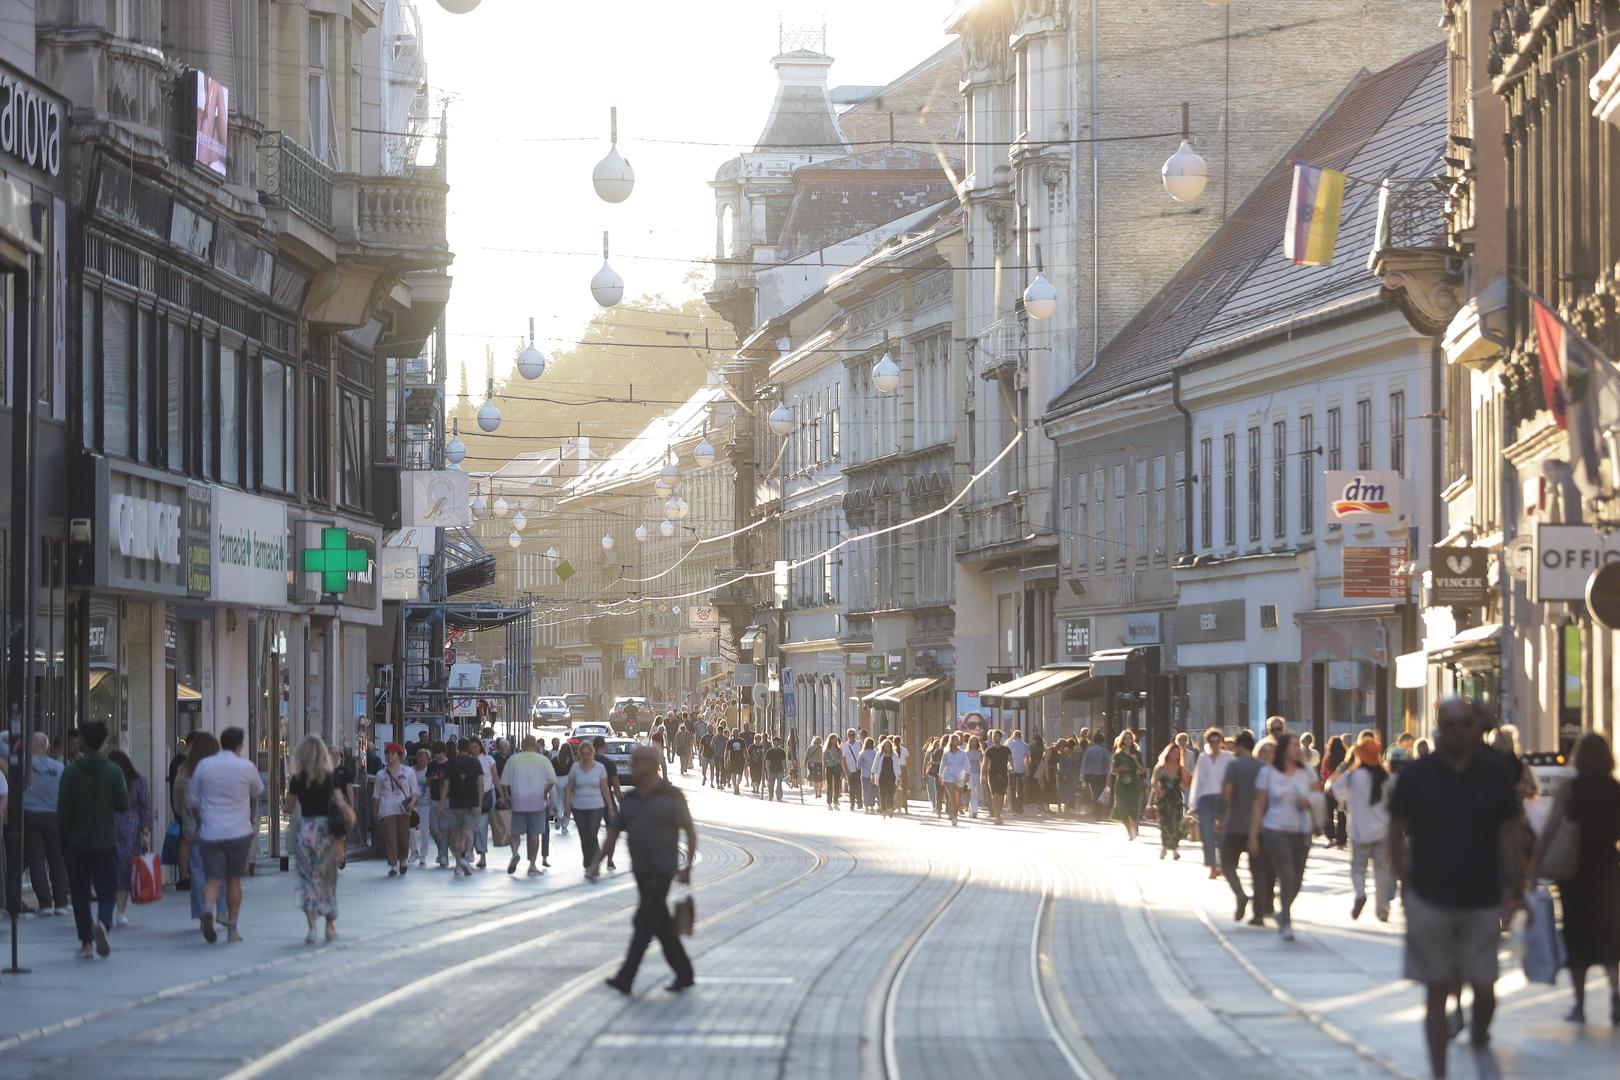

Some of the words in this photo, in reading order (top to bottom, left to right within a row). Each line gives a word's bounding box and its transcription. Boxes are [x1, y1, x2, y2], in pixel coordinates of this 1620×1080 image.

[0, 73, 60, 176] anova
[1345, 477, 1385, 501] dm
[219, 522, 246, 566] farmacia
[253, 530, 279, 572] farmacia
[1436, 577, 1482, 588] VINCEK
